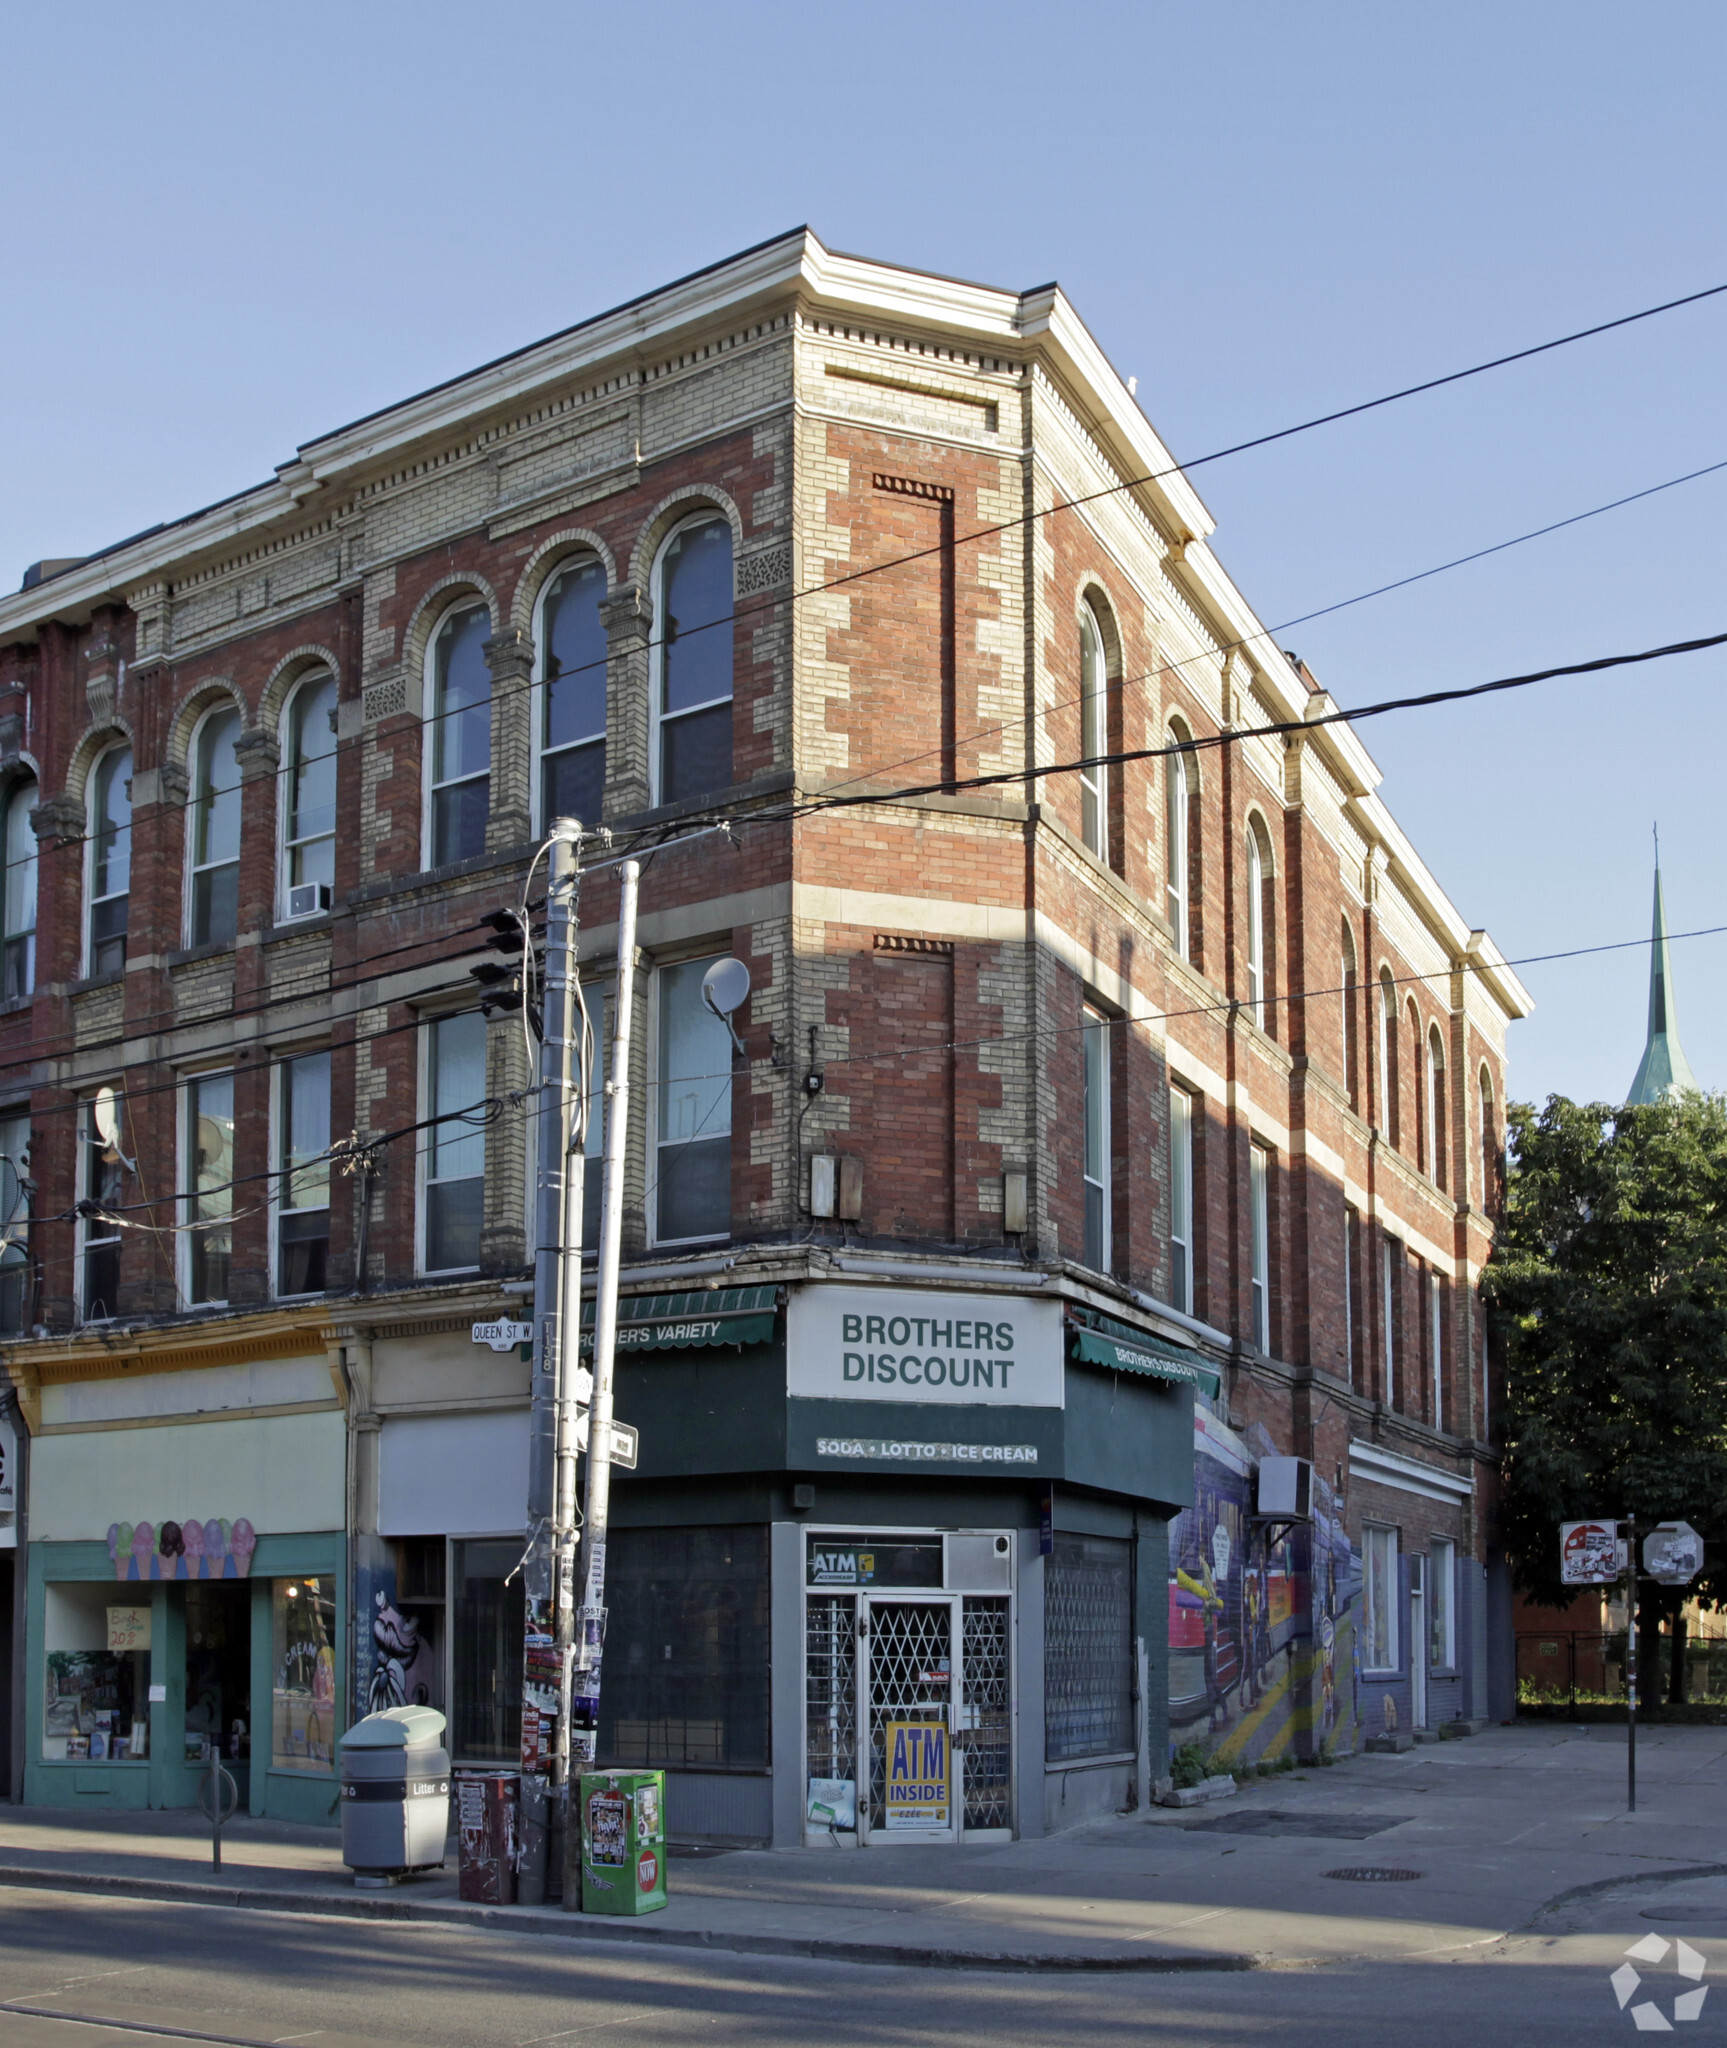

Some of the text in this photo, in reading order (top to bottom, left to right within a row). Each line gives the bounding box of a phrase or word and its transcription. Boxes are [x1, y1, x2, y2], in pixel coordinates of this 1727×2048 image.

[474, 1325, 502, 1339] QUEEN
[656, 1321, 721, 1340] VARIETY
[842, 1314, 1014, 1351] BROTHERS
[843, 1352, 1014, 1388] DISCOUNT
[817, 1440, 1038, 1461] SODA LOTTO ICE CREAM
[813, 1553, 857, 1572] ATM
[891, 1728, 944, 1780] ATM
[413, 1783, 436, 1795] Litter
[890, 1785, 945, 1801] INSIDE
[639, 1862, 656, 1883] NOW
